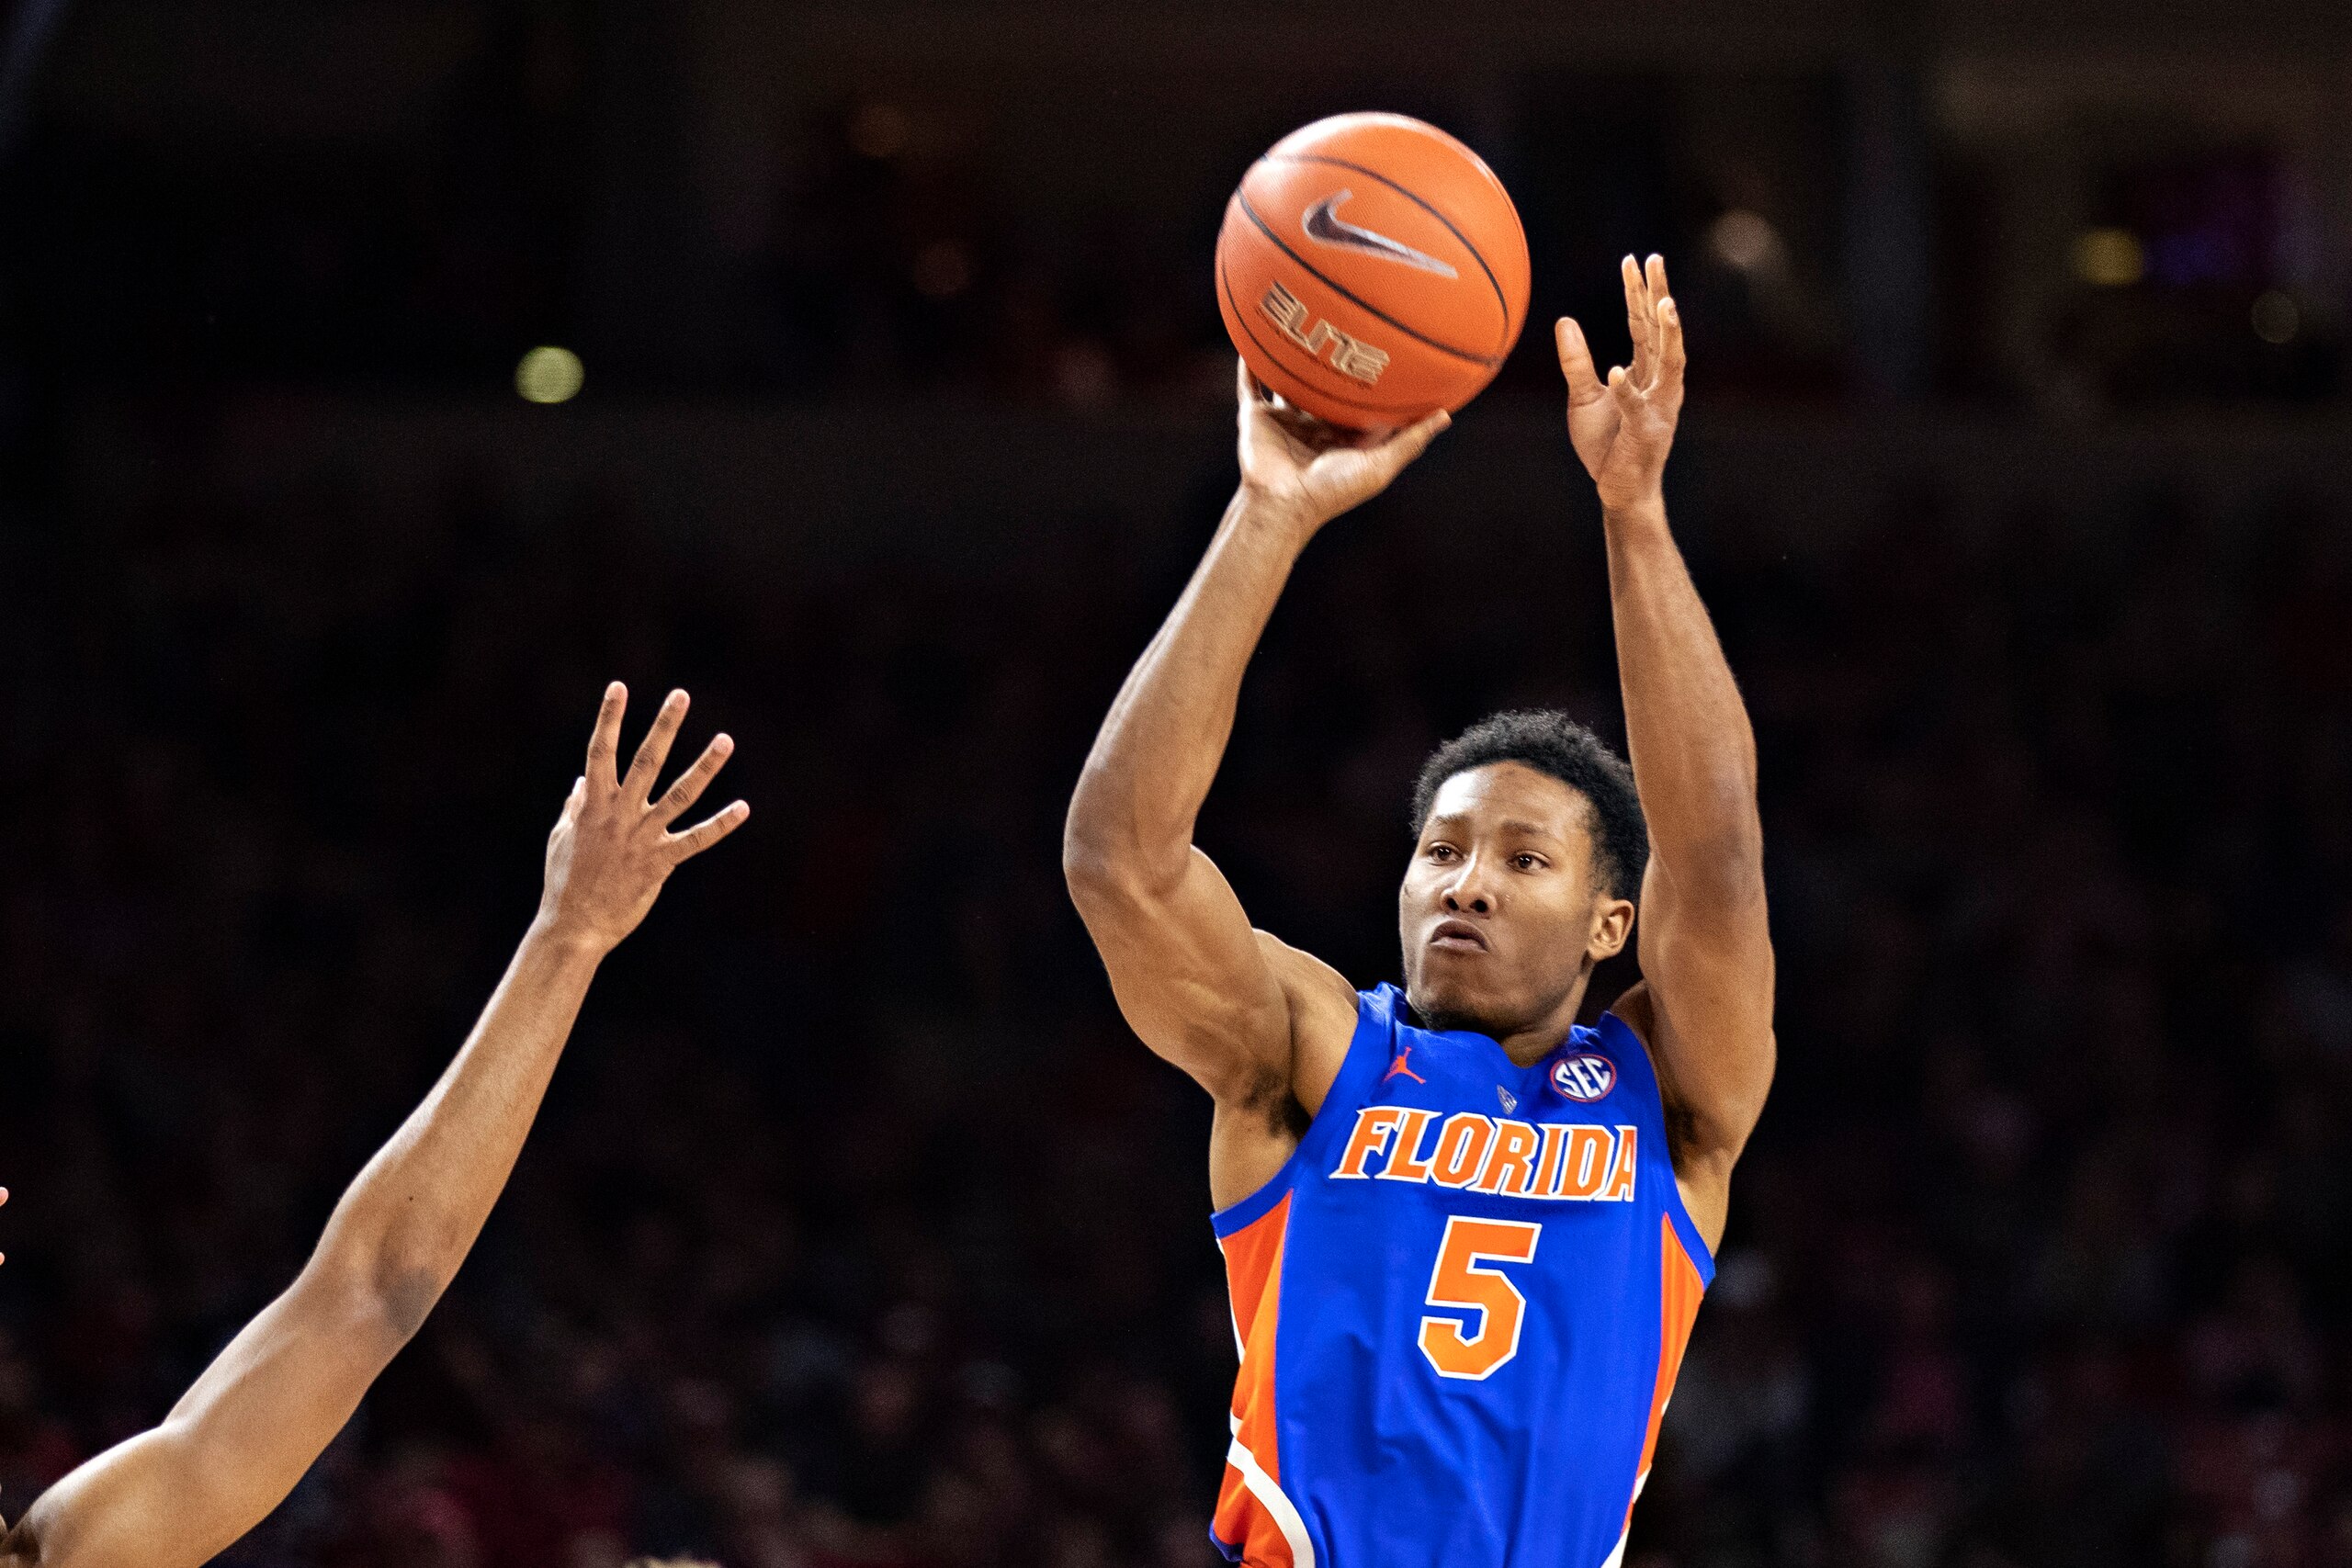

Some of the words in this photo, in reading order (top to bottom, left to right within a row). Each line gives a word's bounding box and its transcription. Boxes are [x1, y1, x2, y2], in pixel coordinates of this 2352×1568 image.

[1555, 1056, 1611, 1099] SEC
[1329, 1105, 1638, 1202] FLORIDA
[1418, 1214, 1543, 1381] 5
